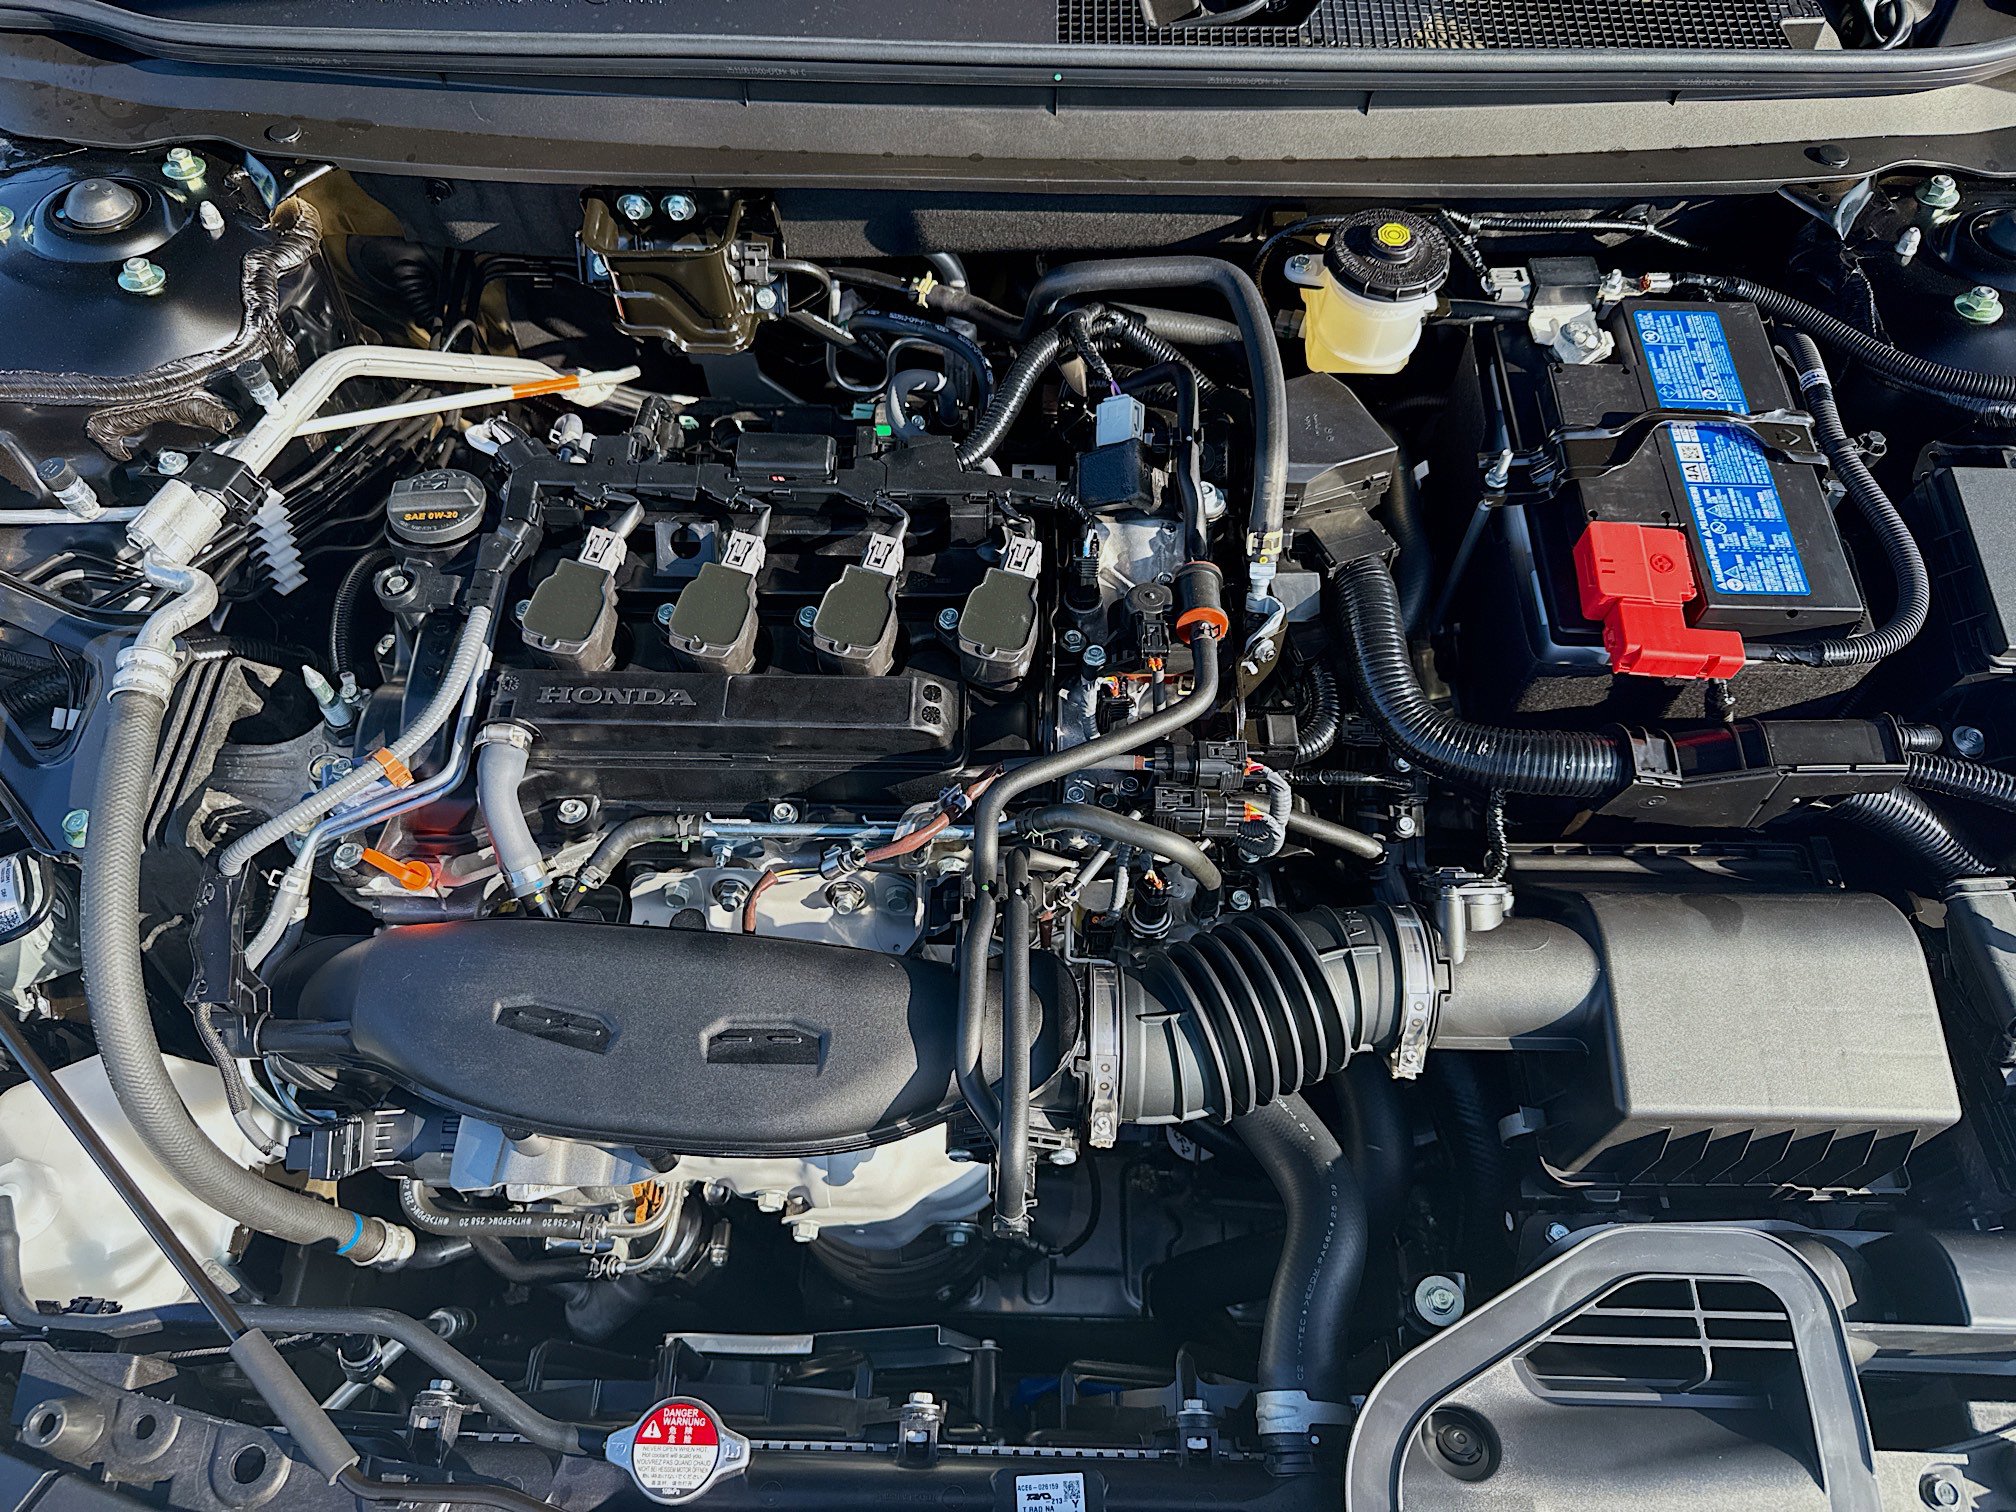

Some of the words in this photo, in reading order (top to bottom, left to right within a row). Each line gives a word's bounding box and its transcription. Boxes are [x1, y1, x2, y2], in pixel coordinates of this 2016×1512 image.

[1684, 464, 1701, 480] 4A
[404, 512, 426, 521] SAE
[428, 511, 458, 520] 0W-20
[536, 686, 697, 706] HONDA
[459, 1218, 469, 1227] 20
[542, 1218, 552, 1227] 20
[664, 1408, 698, 1417] DANGER
[663, 1417, 706, 1426] WARNUNG
[1072, 1500, 1079, 1508] Y
